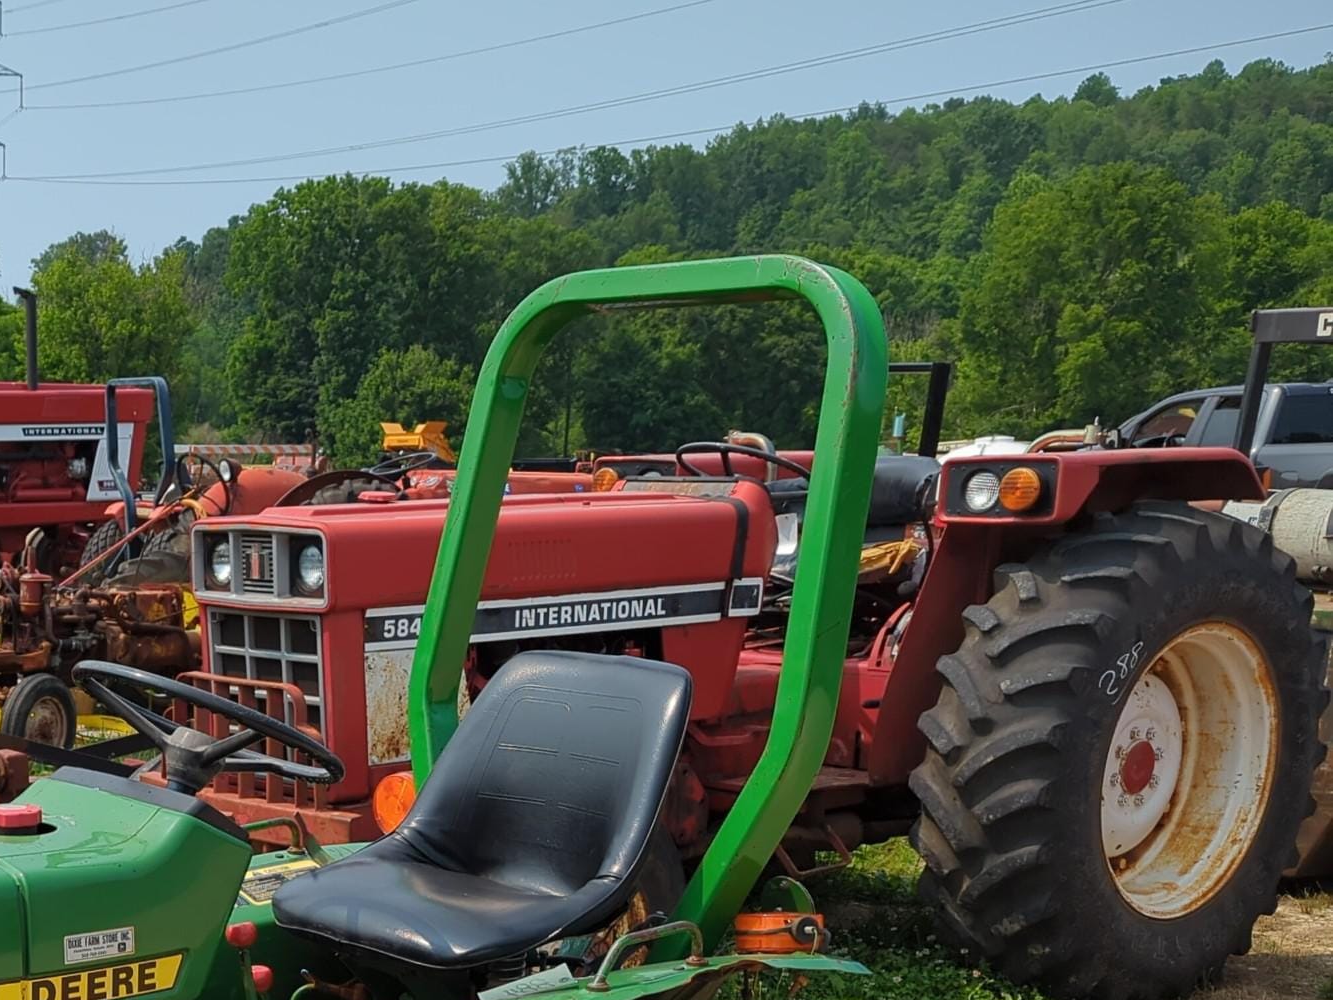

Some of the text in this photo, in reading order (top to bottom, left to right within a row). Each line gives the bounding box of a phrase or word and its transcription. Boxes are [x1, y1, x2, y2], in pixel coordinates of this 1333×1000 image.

[25, 428, 103, 436] INTERNATIONAL
[383, 598, 667, 638] 584 INTERNATIONAL
